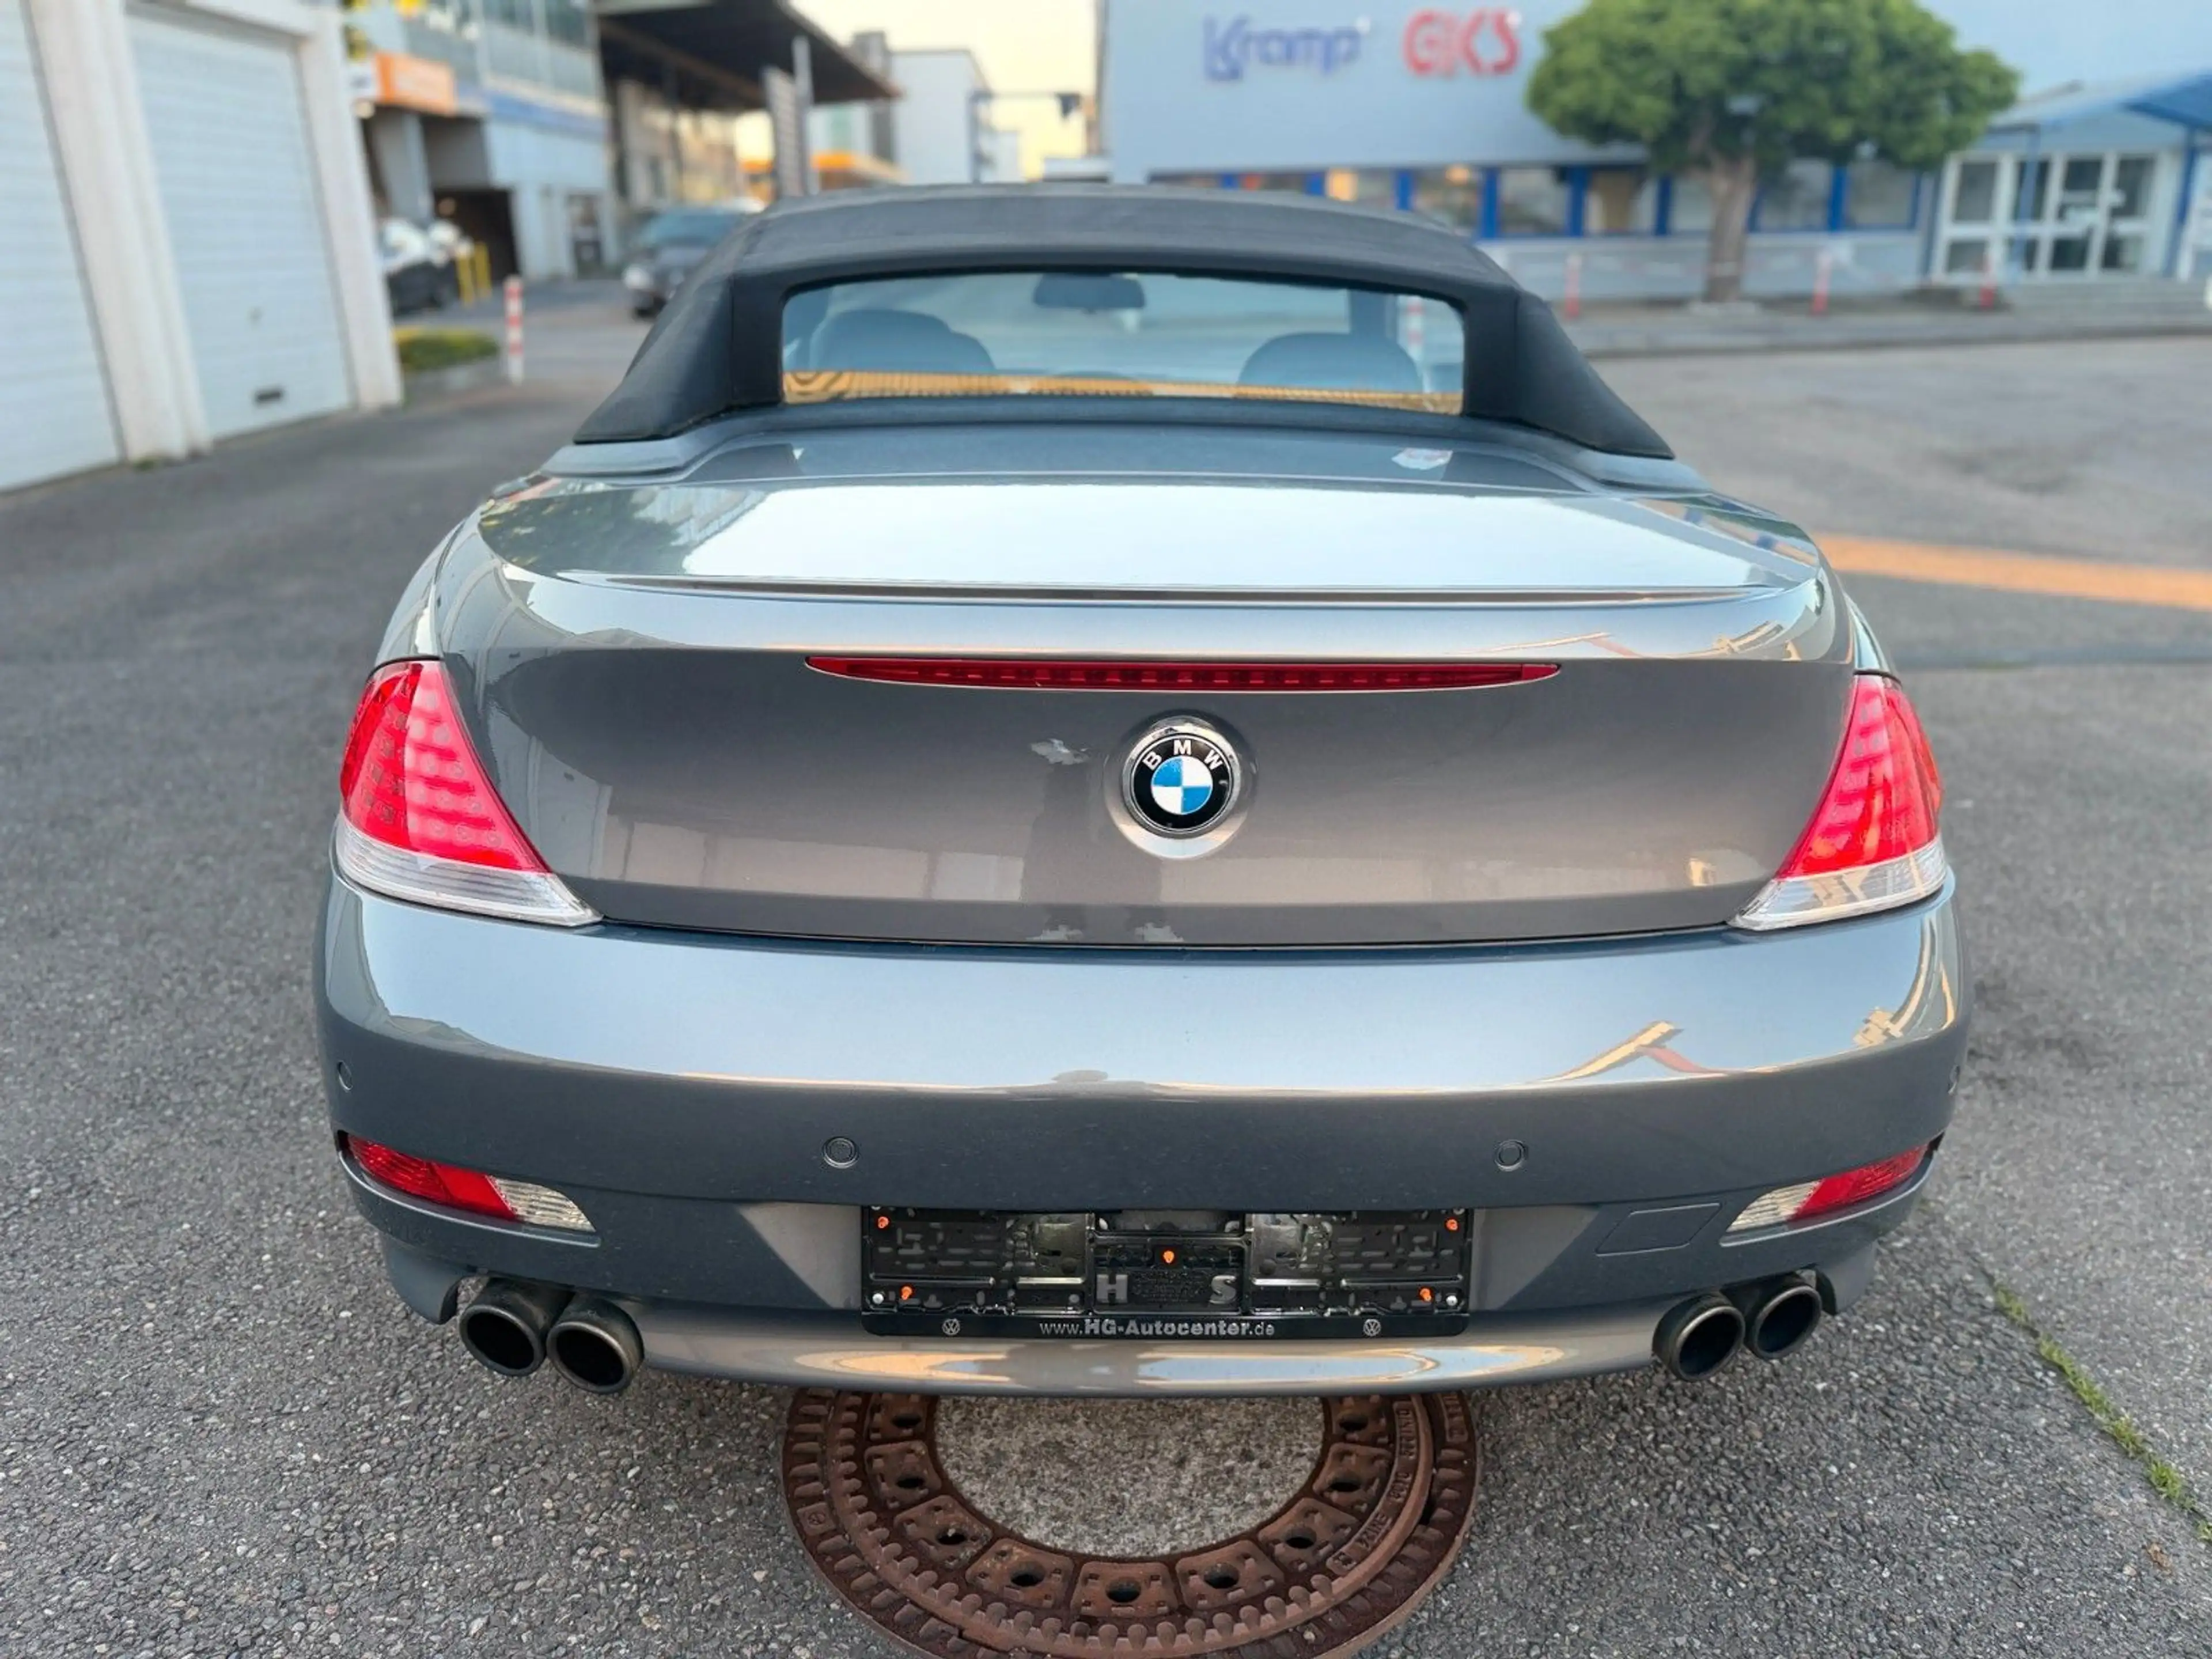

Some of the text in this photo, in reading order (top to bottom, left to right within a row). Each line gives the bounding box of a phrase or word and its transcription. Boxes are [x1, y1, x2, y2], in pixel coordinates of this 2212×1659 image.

[1203, 15, 1361, 79] Kramp
[1142, 739, 1223, 771] BMW
[1039, 1319, 1274, 1336] www.HG-Autocenter.de
